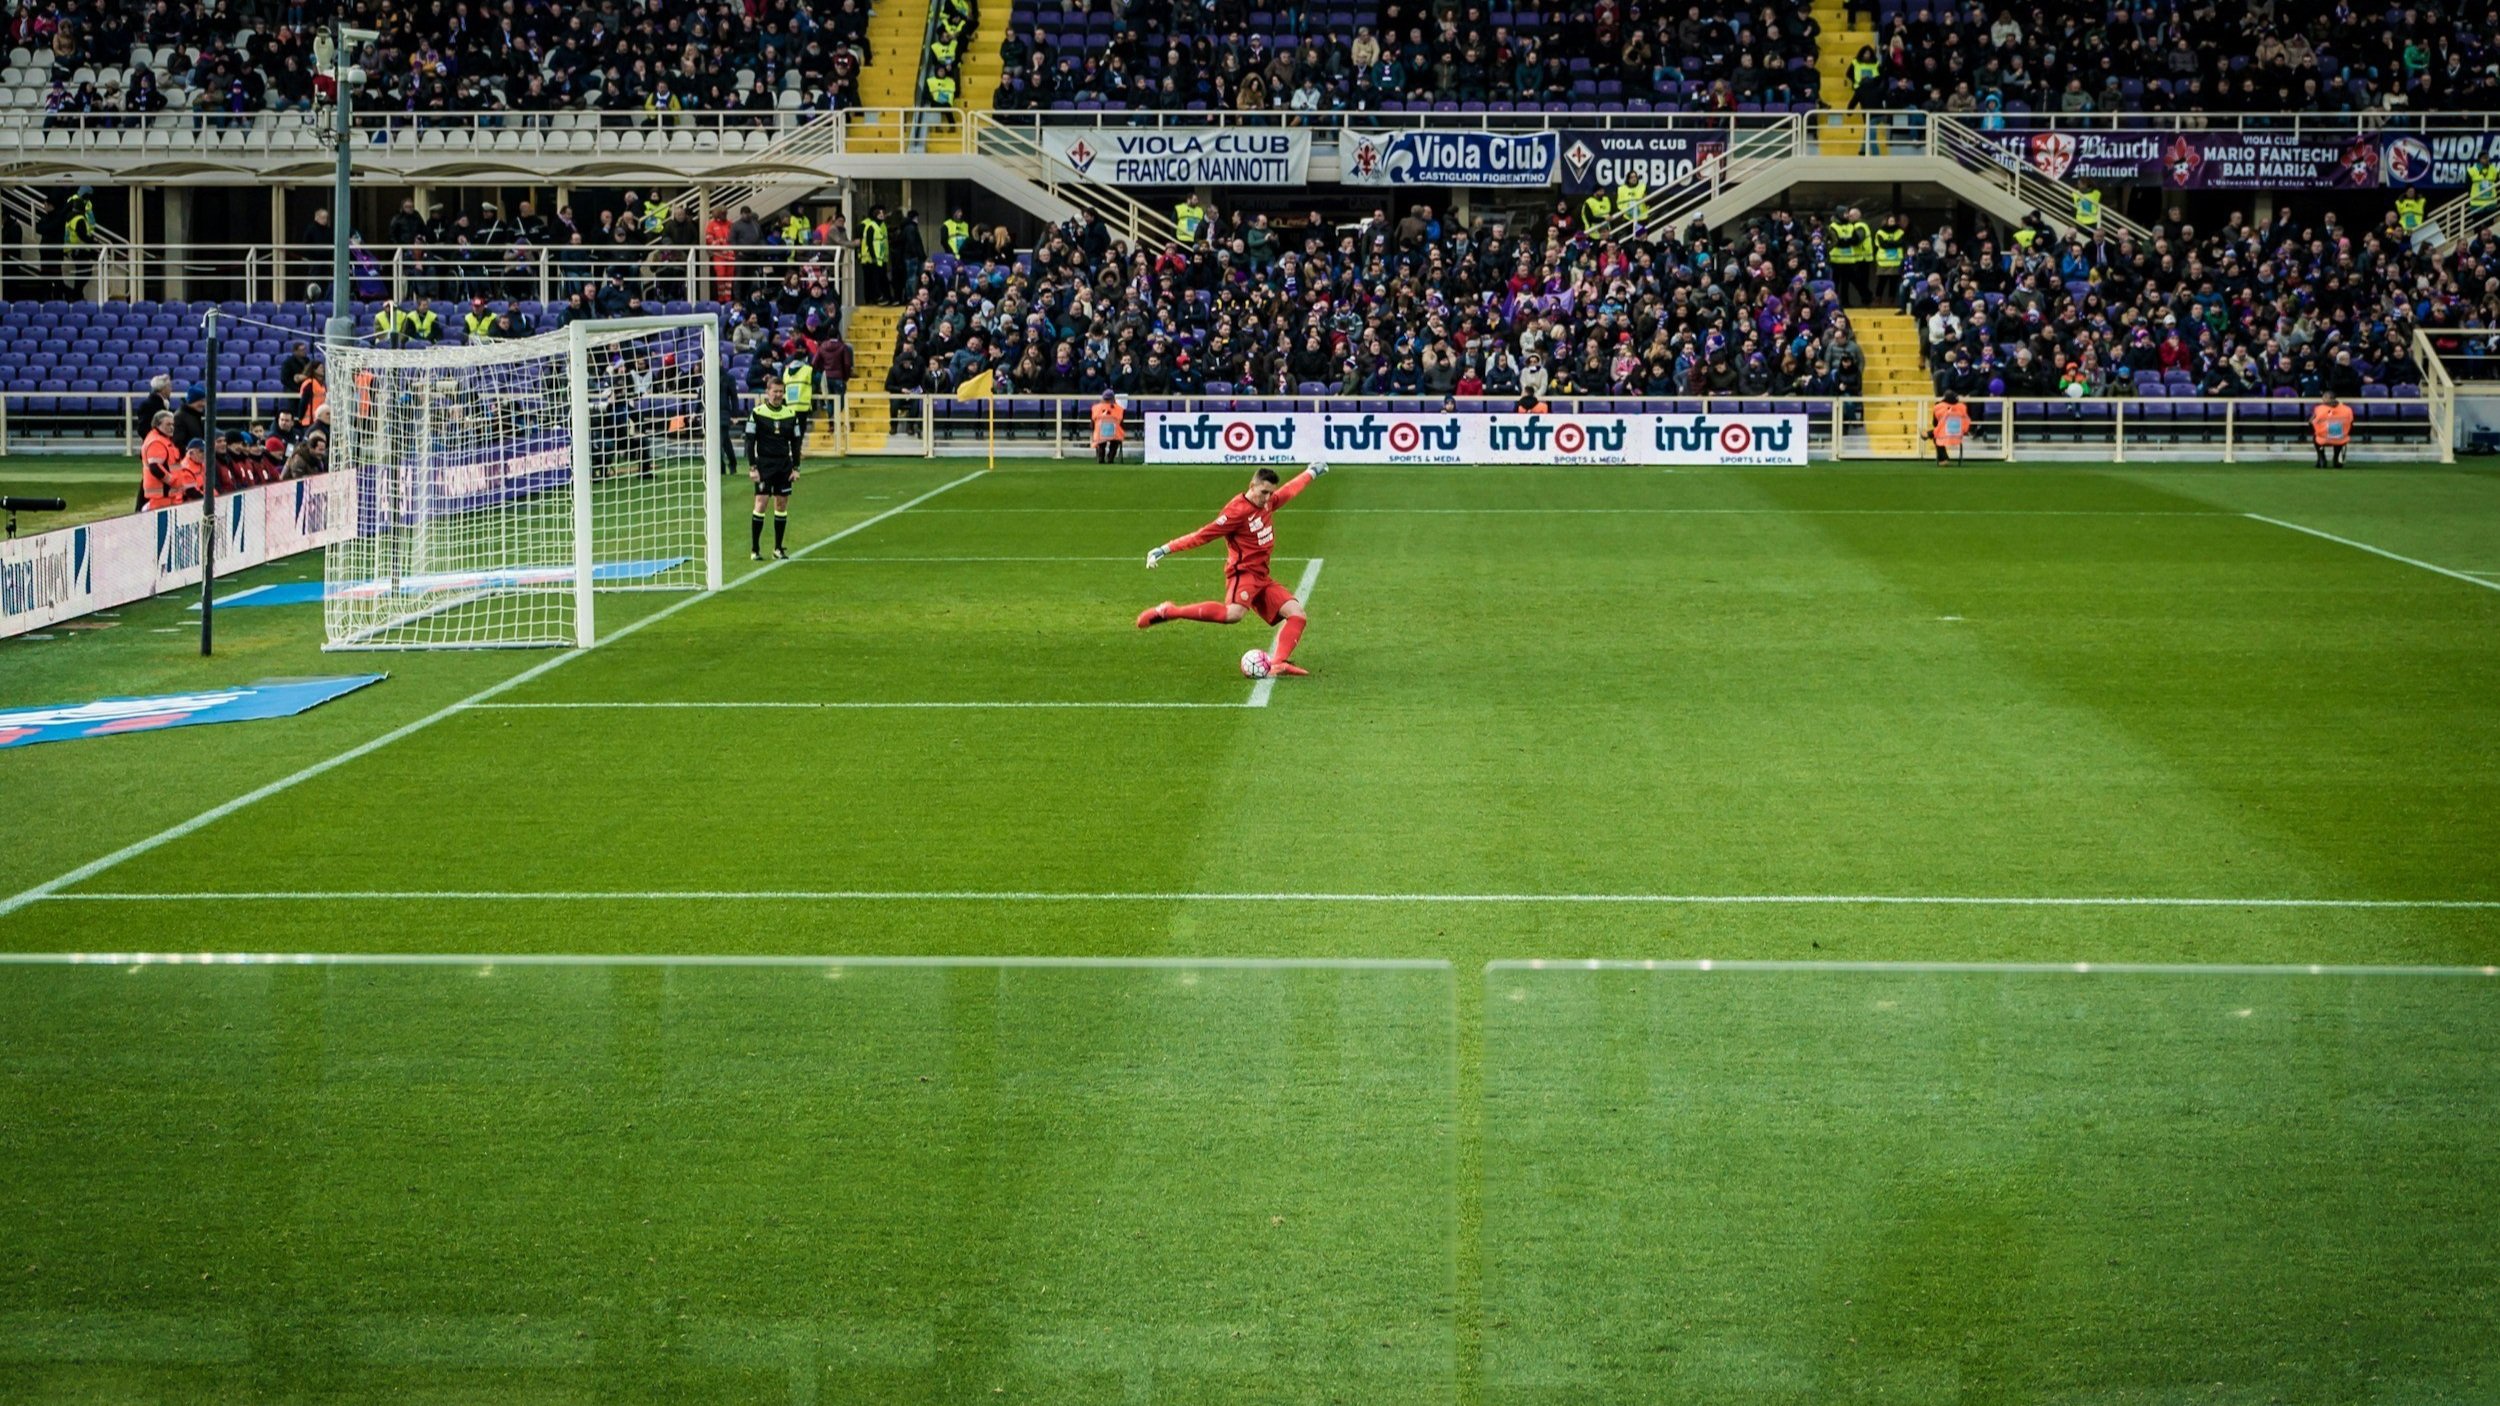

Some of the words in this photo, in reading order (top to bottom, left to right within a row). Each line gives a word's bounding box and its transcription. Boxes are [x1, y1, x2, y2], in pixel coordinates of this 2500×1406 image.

[1117, 135, 1203, 154] VIOLA
[1215, 134, 1290, 153] CLUB
[1601, 138, 1644, 150] VIOLA
[1650, 138, 1687, 150] CLUB
[2078, 134, 2159, 159] Bianchi
[2243, 134, 2272, 145] VIOLA
[2274, 135, 2299, 146] CLUB
[1414, 135, 1481, 169] Viola
[1489, 136, 1546, 169] Club
[2204, 146, 2256, 161] MARIO
[2260, 147, 2339, 163] FANTECHI
[1116, 158, 1191, 181] FRANCO
[1201, 157, 1289, 182] NANNOTTI
[1419, 171, 1481, 182] CASTIGLION
[1483, 172, 1546, 182] FIORENTINO
[2072, 163, 2139, 178] Montuori
[2223, 162, 2256, 177] BAR
[2259, 162, 2318, 178] MARISA
[1159, 414, 1296, 452] infront
[1324, 414, 1461, 452] infront
[1489, 415, 1627, 454] infront
[1655, 415, 1793, 454] infront
[1224, 453, 1258, 462] SPORTS
[1269, 453, 1296, 462] MEDIA
[1389, 455, 1422, 463] SPORTS
[1434, 455, 1461, 463] MEDIA
[1554, 455, 1588, 463] SPORTS
[1599, 455, 1627, 463] MEDIA
